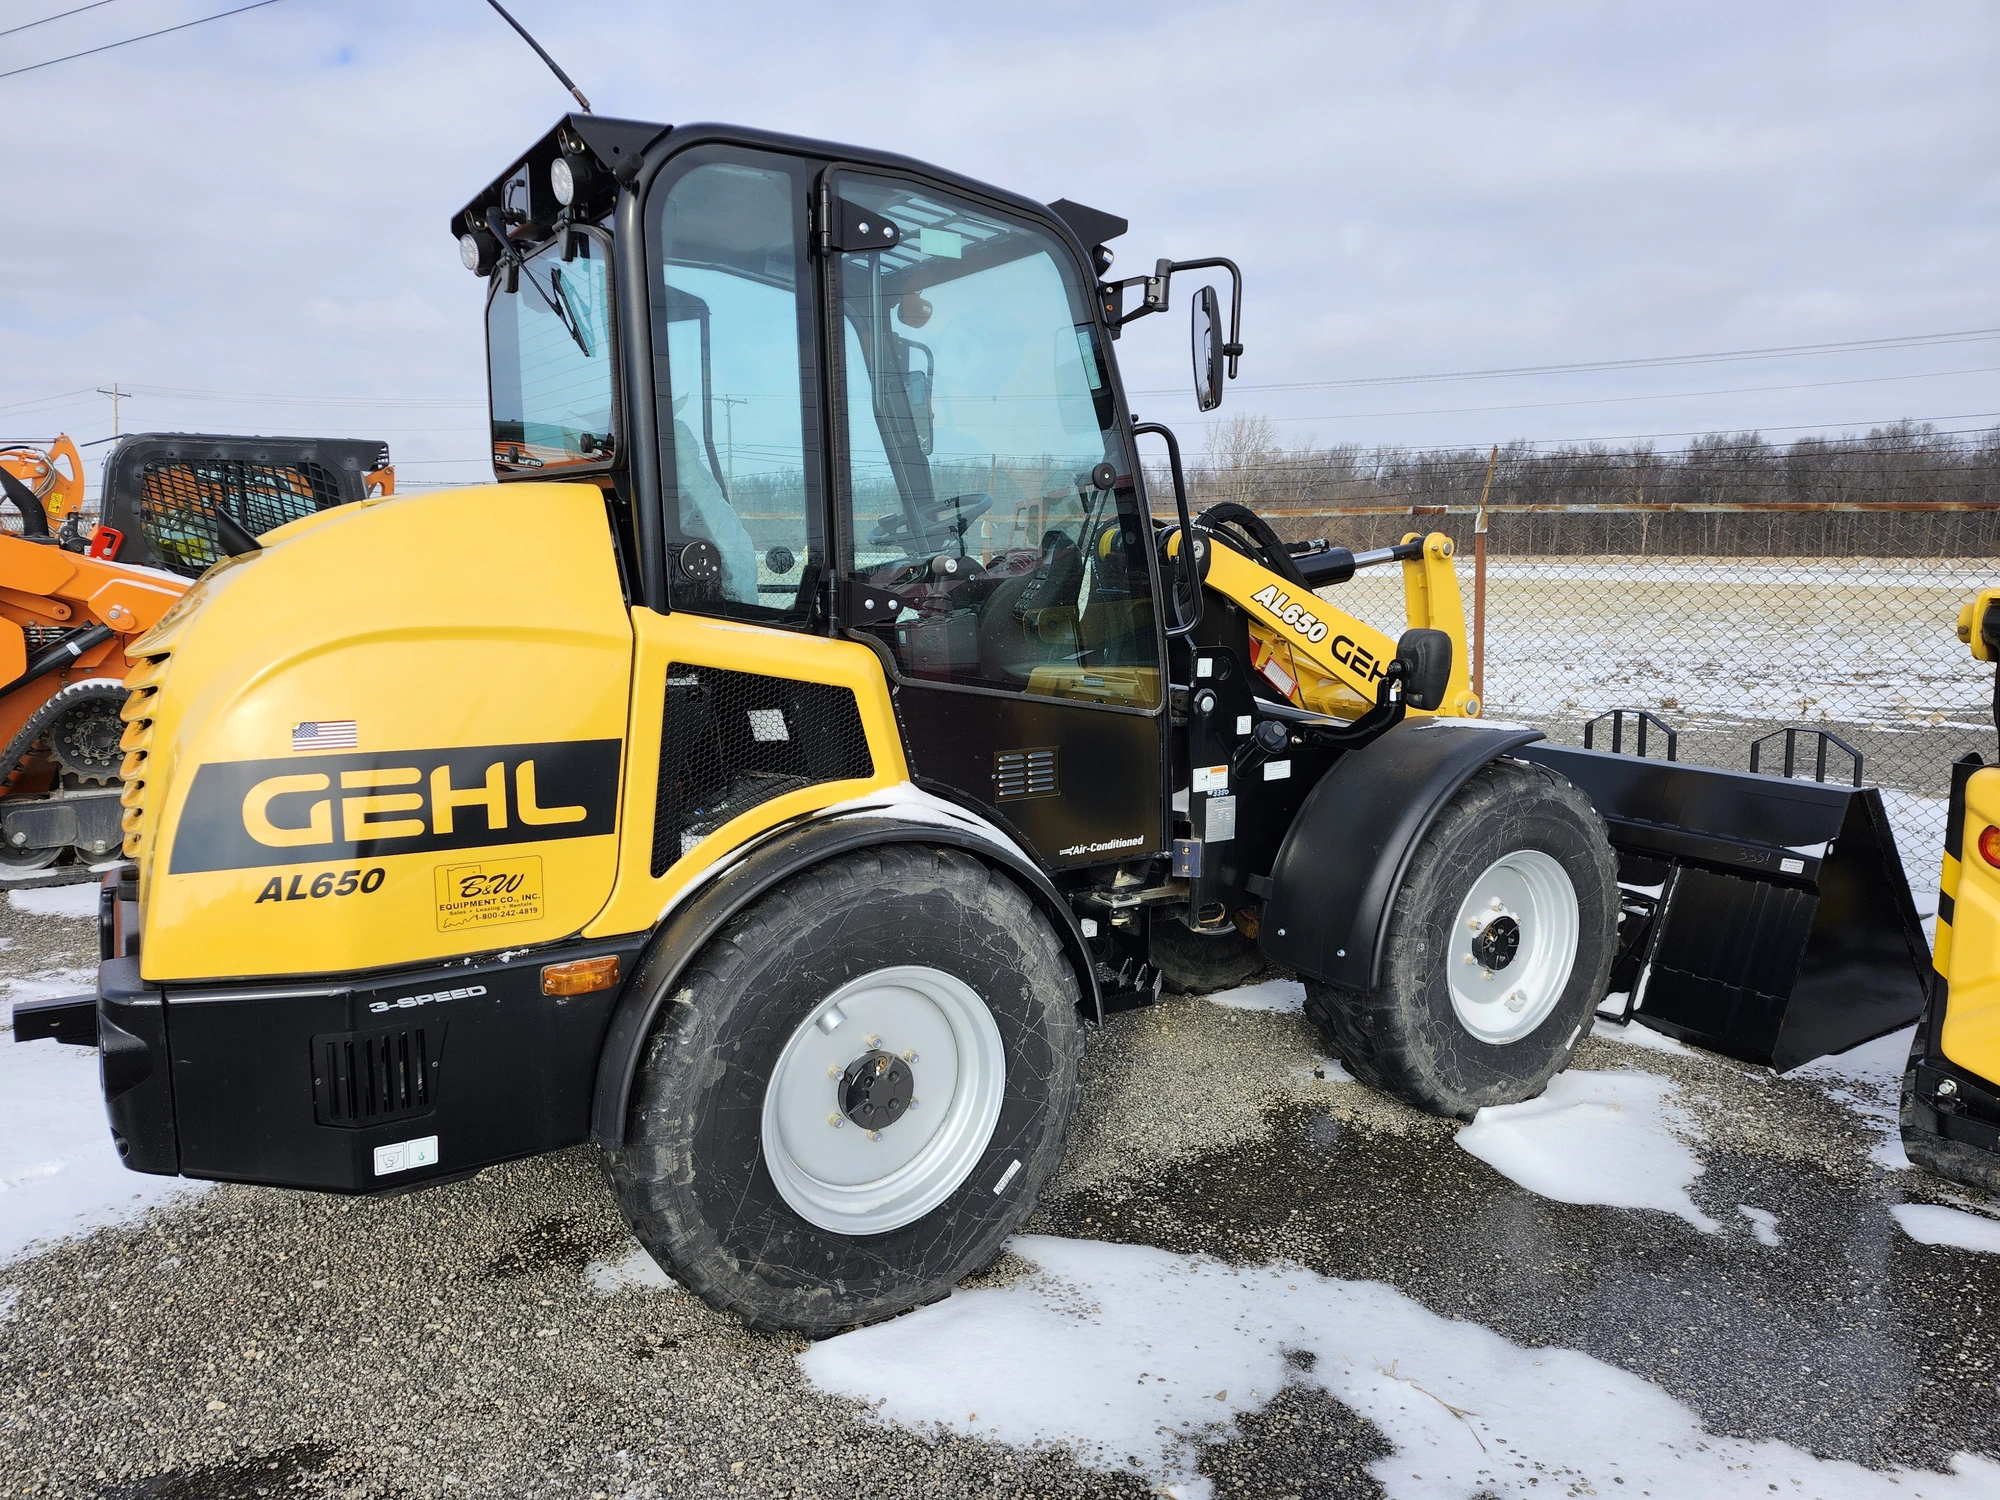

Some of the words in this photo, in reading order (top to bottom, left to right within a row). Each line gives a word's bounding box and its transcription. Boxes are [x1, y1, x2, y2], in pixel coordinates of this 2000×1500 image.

[1250, 584, 1329, 643] AL650
[1331, 635, 1387, 683] GEH
[242, 760, 587, 847] GEHL
[1072, 835, 1144, 855] Air-Conditioned
[254, 868, 386, 904] AL650
[459, 873, 524, 898] B&W
[439, 898, 497, 911] EQUIPMENT
[500, 896, 519, 904] CO.,
[521, 893, 541, 901] INC.
[475, 907, 538, 921] 1-800-242-4819
[368, 985, 487, 1013] 3-SPEED
